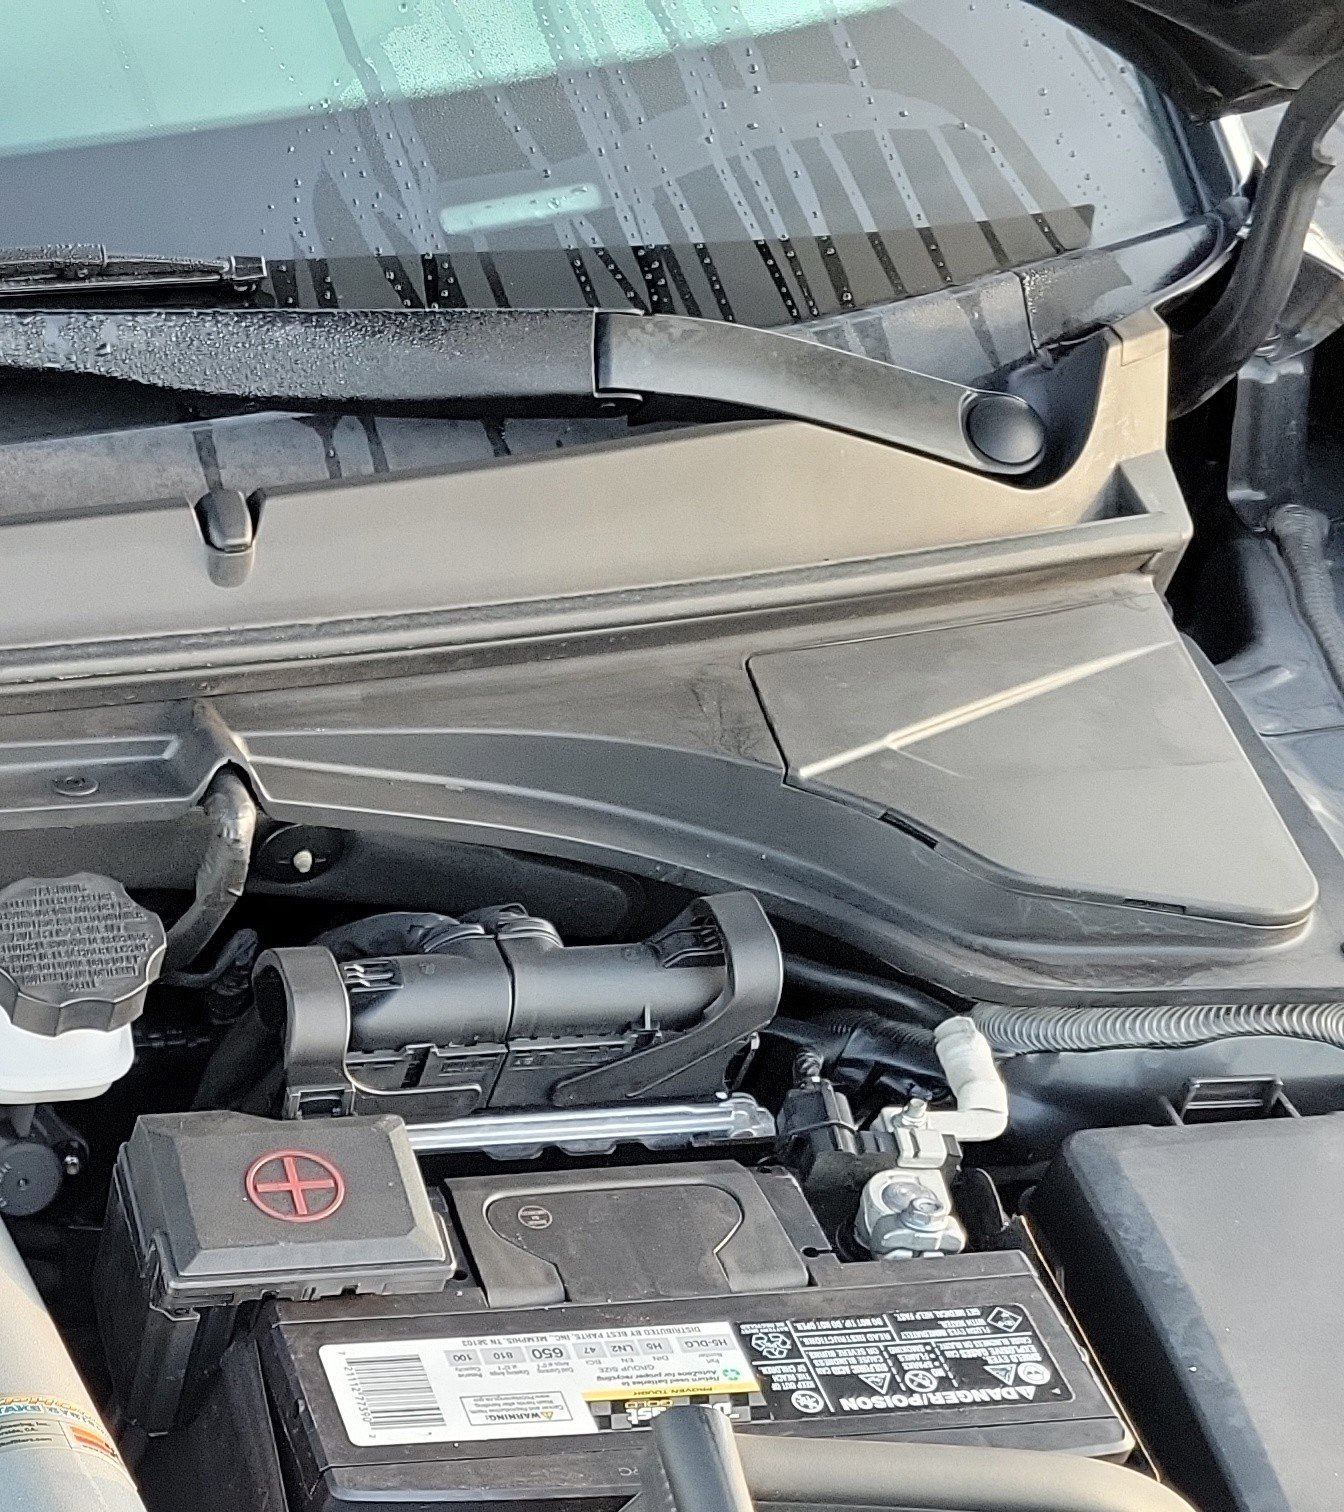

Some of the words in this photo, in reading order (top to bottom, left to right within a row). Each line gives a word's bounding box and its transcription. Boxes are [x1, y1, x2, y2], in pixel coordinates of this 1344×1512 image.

[606, 1331, 628, 1339] BEST
[643, 1326, 701, 1337] DISTRIBUTED
[645, 1342, 663, 1350] H5
[684, 1339, 728, 1348] H5-DLG
[584, 1346, 596, 1354] 47
[611, 1344, 634, 1352] LN2
[493, 1352, 513, 1360] 810
[532, 1347, 563, 1360] 650
[452, 1354, 473, 1362] 100
[621, 1364, 655, 1372] GROUP
[635, 1371, 663, 1379] proper
[677, 1369, 717, 1377] AutoZone
[596, 1373, 633, 1382] recycling
[839, 1386, 1020, 1411] DANGER/POISON
[624, 1397, 673, 1409] GOLD
[485, 1412, 541, 1421] WARNING:
